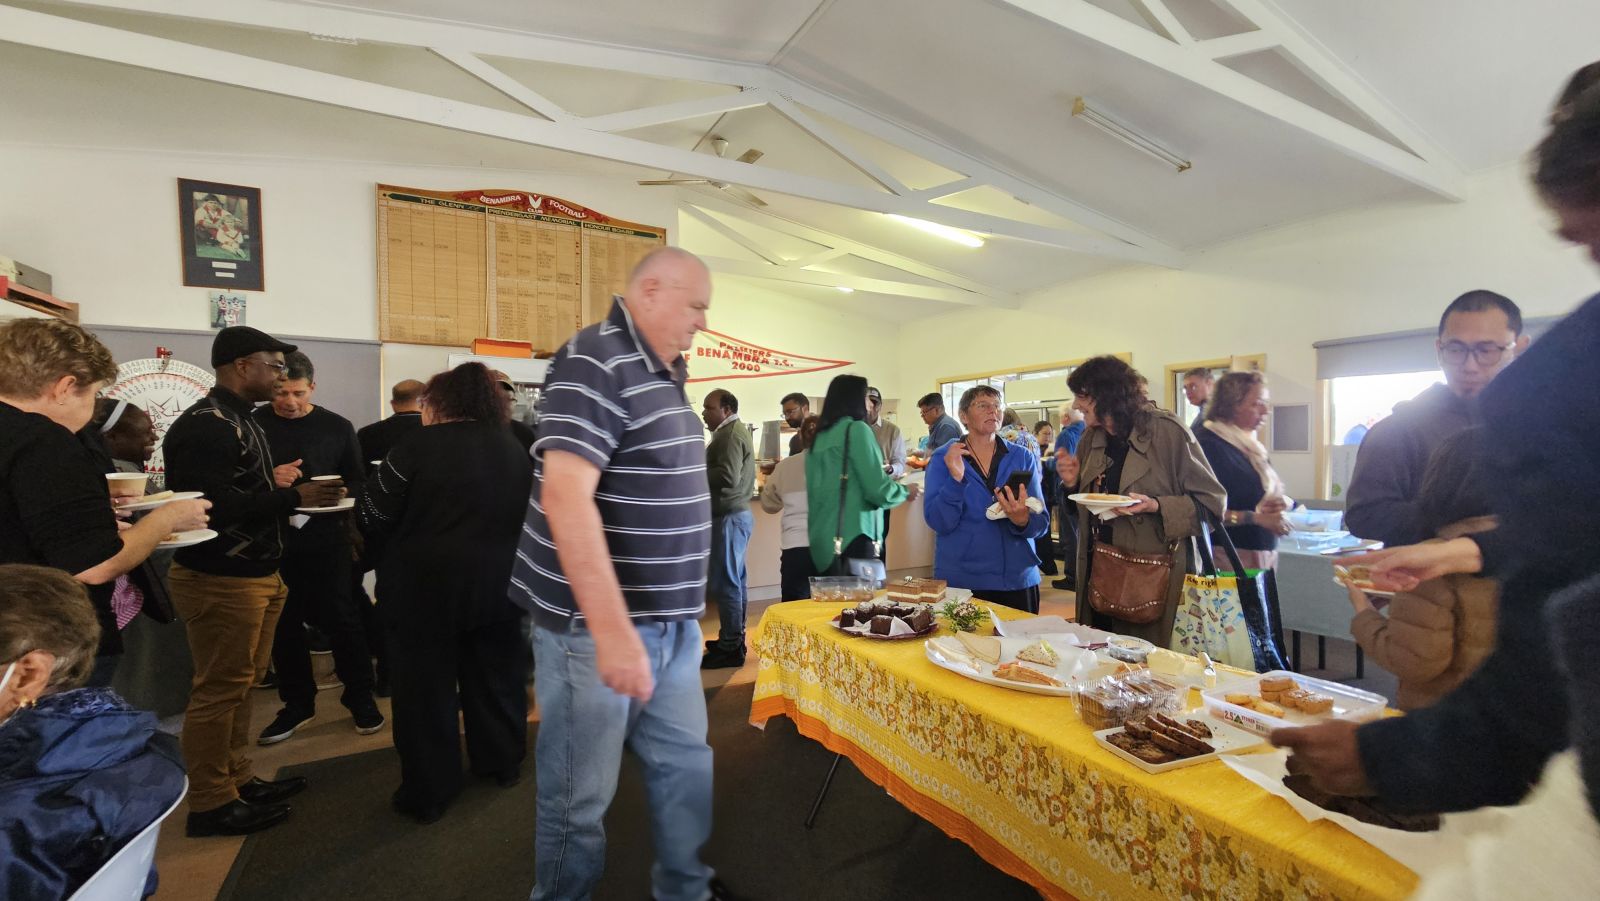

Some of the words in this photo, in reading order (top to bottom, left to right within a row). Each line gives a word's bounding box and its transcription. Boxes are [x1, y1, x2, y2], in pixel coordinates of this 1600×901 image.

[438, 200, 465, 209] GLENN
[488, 208, 536, 220] PRENDERGAST
[540, 216, 576, 226] MEMORIAL
[584, 223, 611, 232] HONOUR
[611, 227, 635, 235] BOARD
[480, 195, 521, 205] BENAMBRA
[549, 200, 587, 219] FOOTBALL
[697, 346, 769, 365] BENAMBRA
[731, 361, 761, 372] 2000
